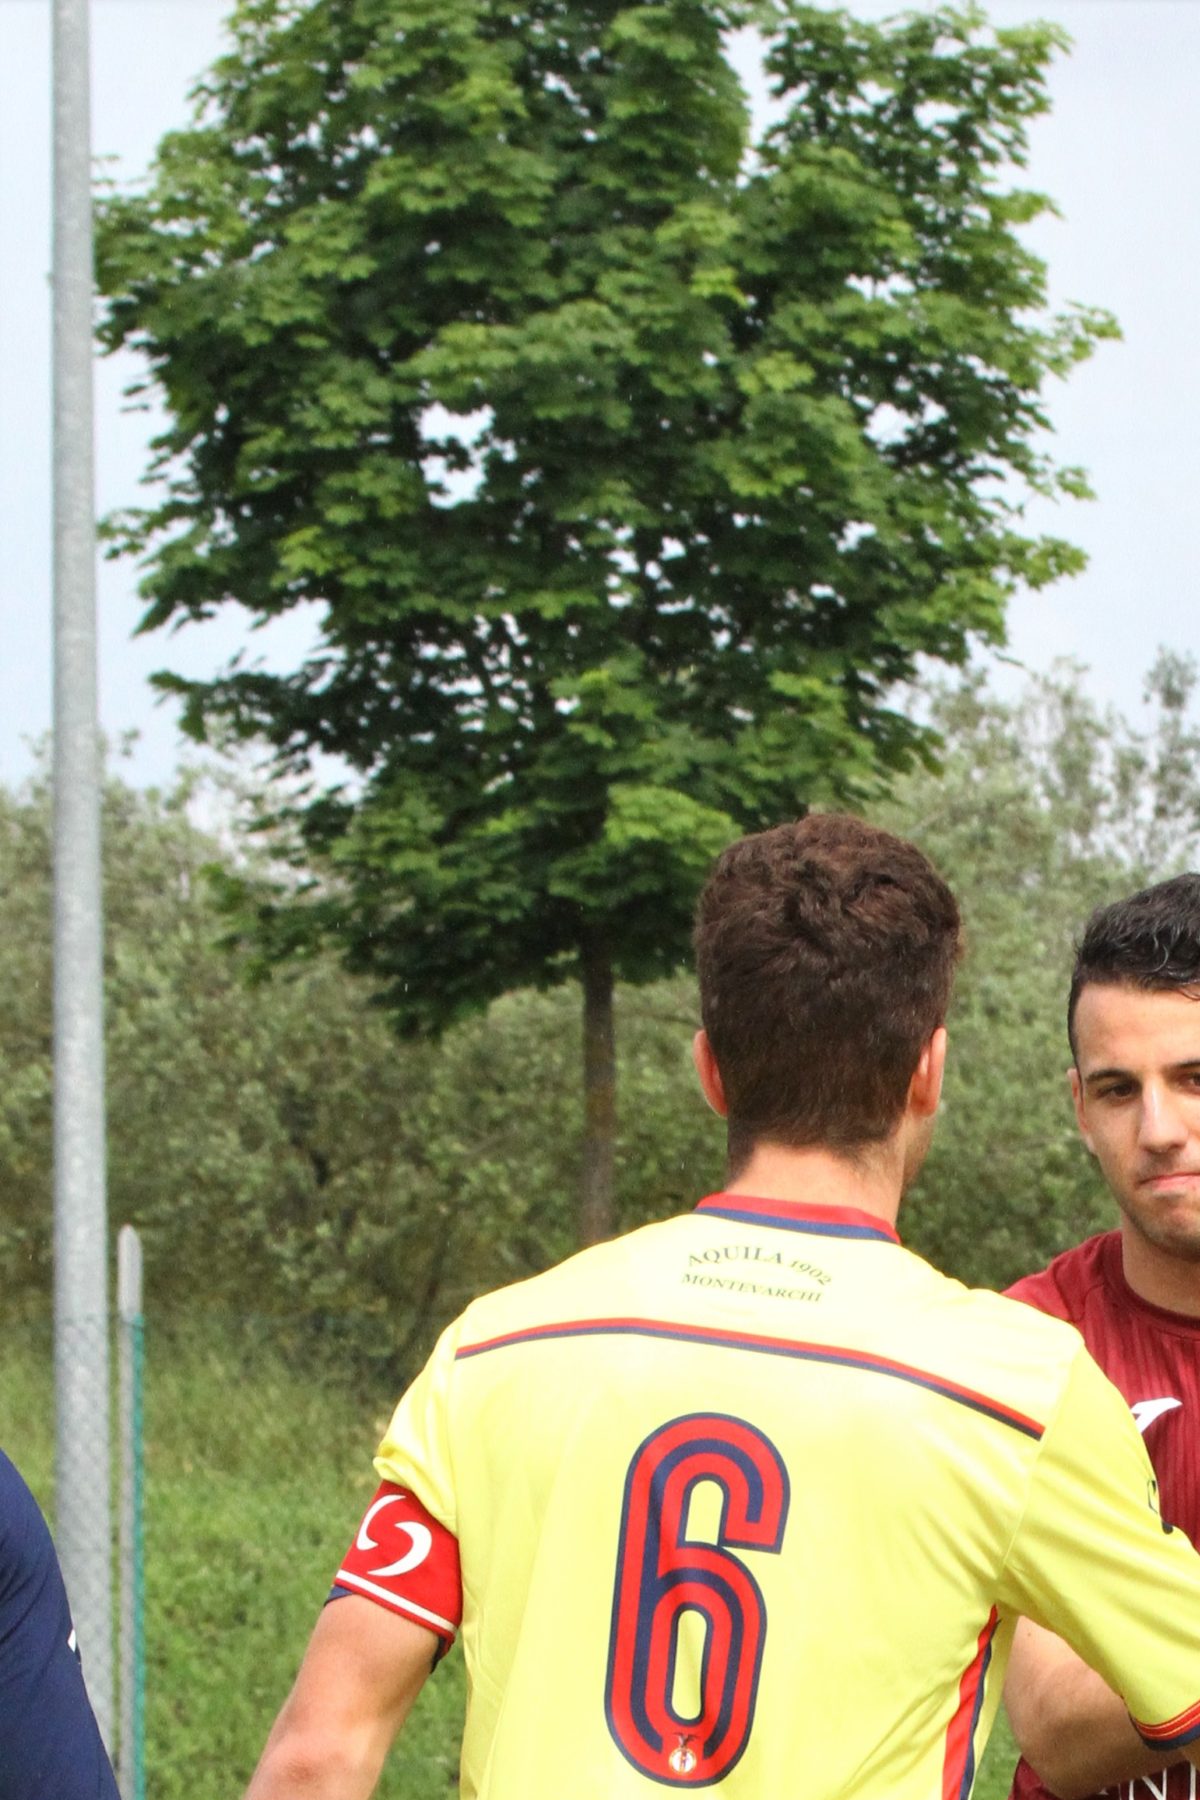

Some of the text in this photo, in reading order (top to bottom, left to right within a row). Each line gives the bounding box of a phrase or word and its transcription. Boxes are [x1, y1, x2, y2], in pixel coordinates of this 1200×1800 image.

[689, 1245, 832, 1286] AQUILA 1902
[681, 1272, 823, 1303] MONTEVARCHI
[604, 1411, 791, 1788] 6
